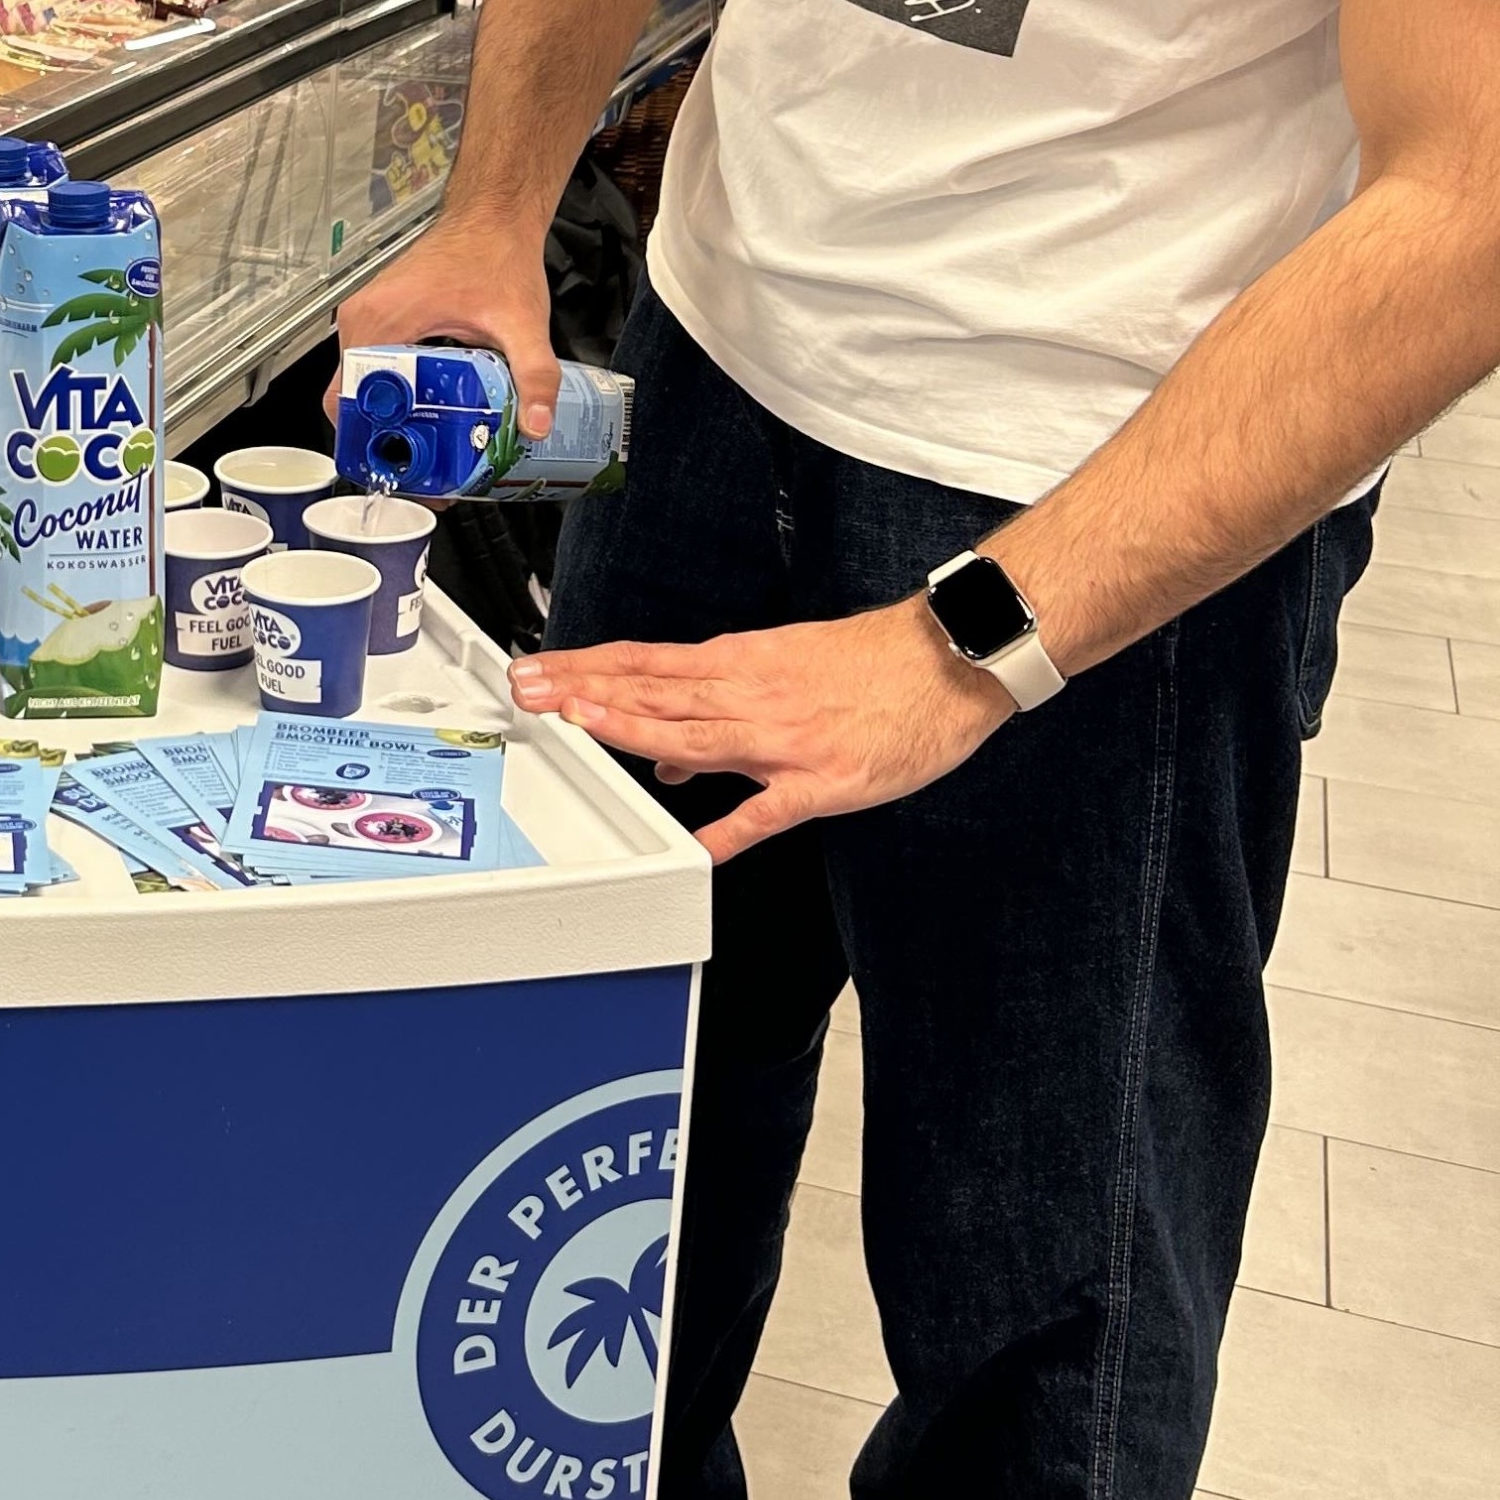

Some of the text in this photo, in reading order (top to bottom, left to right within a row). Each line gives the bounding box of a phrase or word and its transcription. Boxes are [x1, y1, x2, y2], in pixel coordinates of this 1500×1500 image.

[12, 366, 145, 430] VITA
[6, 429, 156, 482] COCO
[13, 465, 149, 548] Coconut
[75, 526, 143, 550] WATER
[47, 555, 148, 570] KOKOSWASSER
[189, 620, 223, 634] FEEL
[251, 608, 283, 634] VITA
[211, 635, 243, 652] FUEL
[253, 631, 292, 651] COCO
[267, 658, 306, 680] GOOD
[260, 672, 286, 695] FUEL
[275, 731, 420, 752] SMOOTHIE BOWL
[276, 722, 370, 739] BROMBEER
[453, 1128, 679, 1376] DER PERFE
